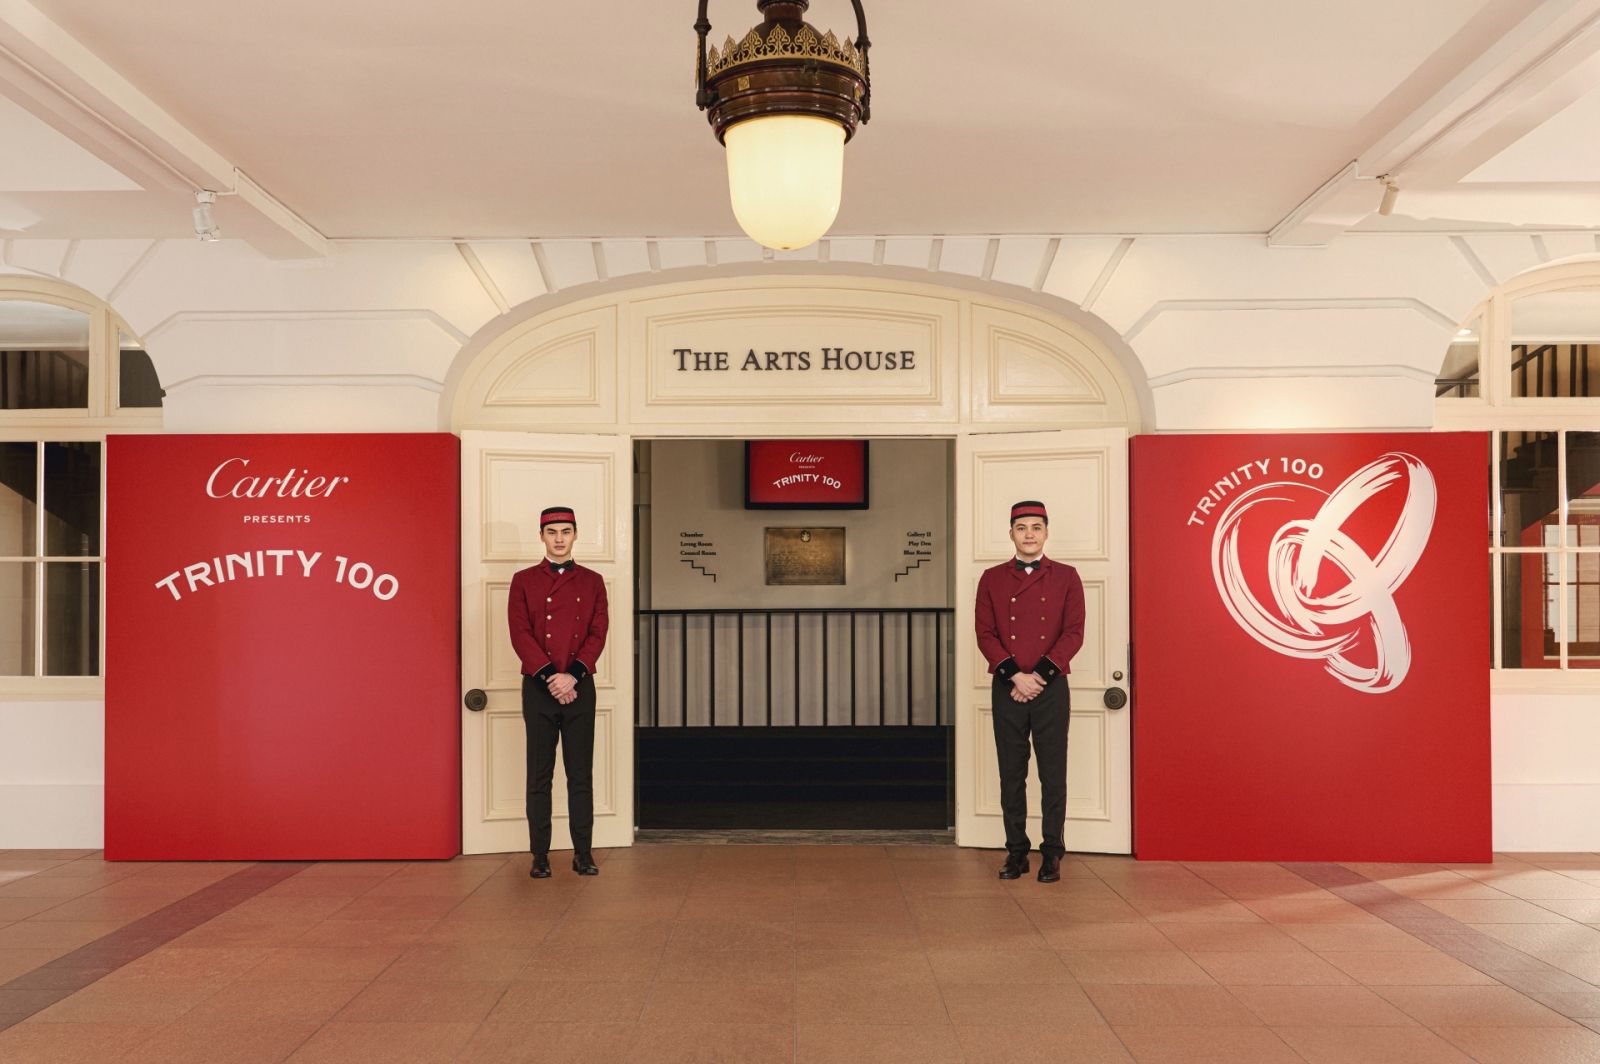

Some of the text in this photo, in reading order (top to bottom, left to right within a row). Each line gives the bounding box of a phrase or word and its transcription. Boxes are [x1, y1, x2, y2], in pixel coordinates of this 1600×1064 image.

[673, 348, 916, 372] THE ARTS HOUSE
[789, 451, 825, 463] Cartier
[206, 457, 349, 499] Cartier
[773, 473, 842, 489] TRINITY 100
[1186, 456, 1324, 527] TRINITY 100
[243, 515, 311, 524] PRESENTS
[155, 549, 399, 602] TRINITY 100
